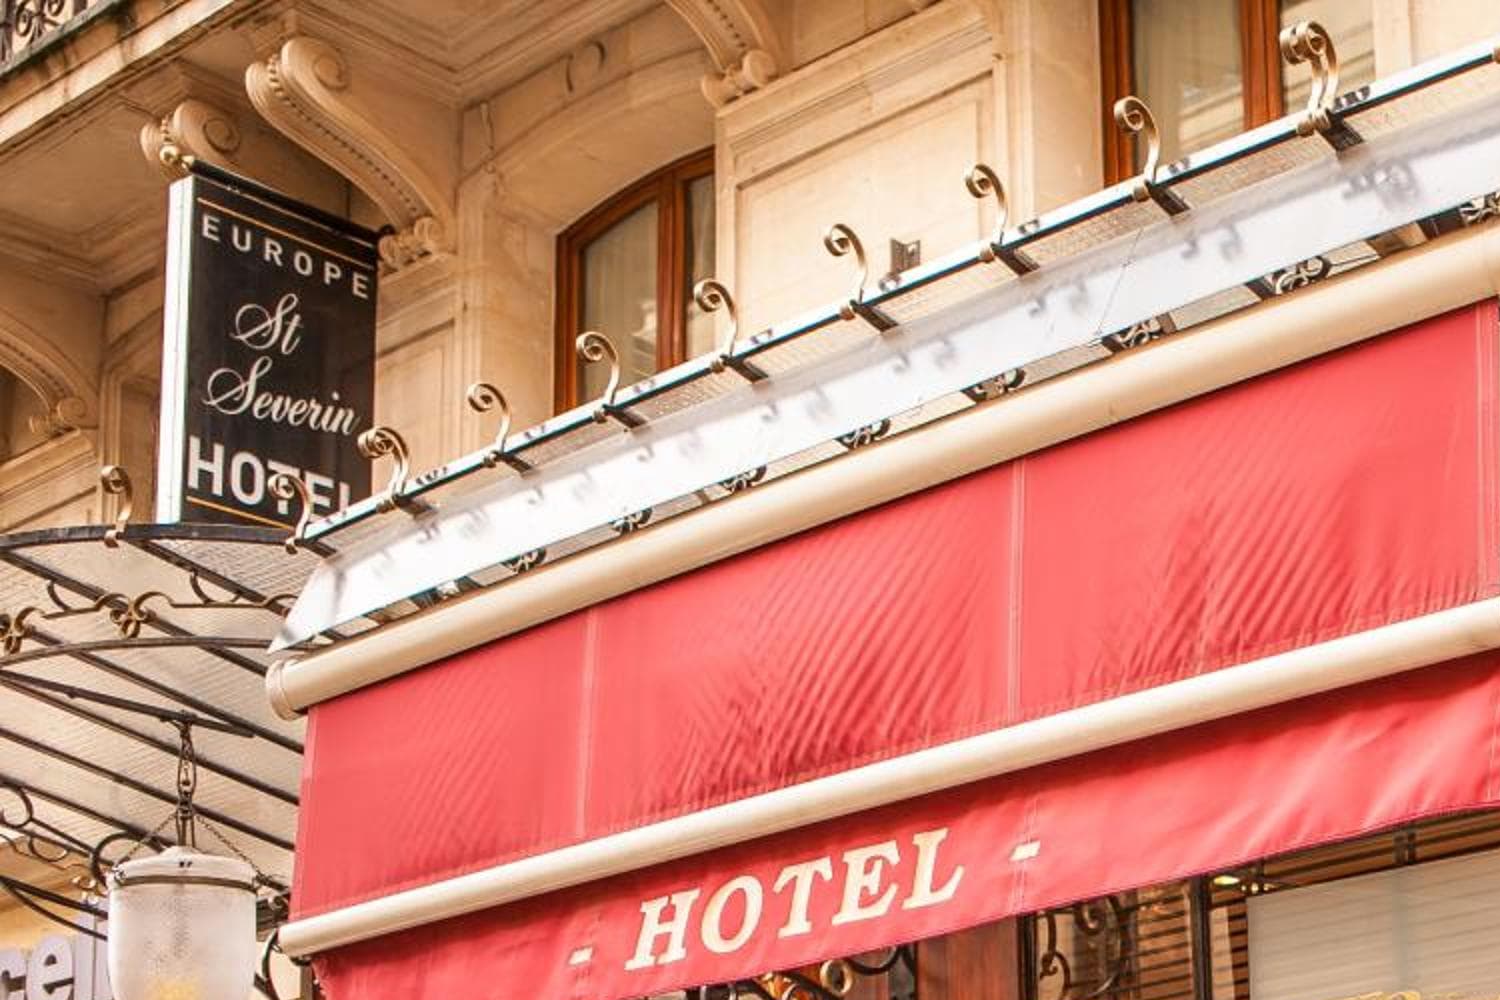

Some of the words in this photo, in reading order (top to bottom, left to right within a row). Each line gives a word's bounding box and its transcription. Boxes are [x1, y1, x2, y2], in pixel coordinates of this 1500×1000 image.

[202, 214, 369, 299] EUROPE
[229, 293, 303, 355] St
[202, 356, 361, 435] Severin
[624, 828, 965, 970] HOTEL
